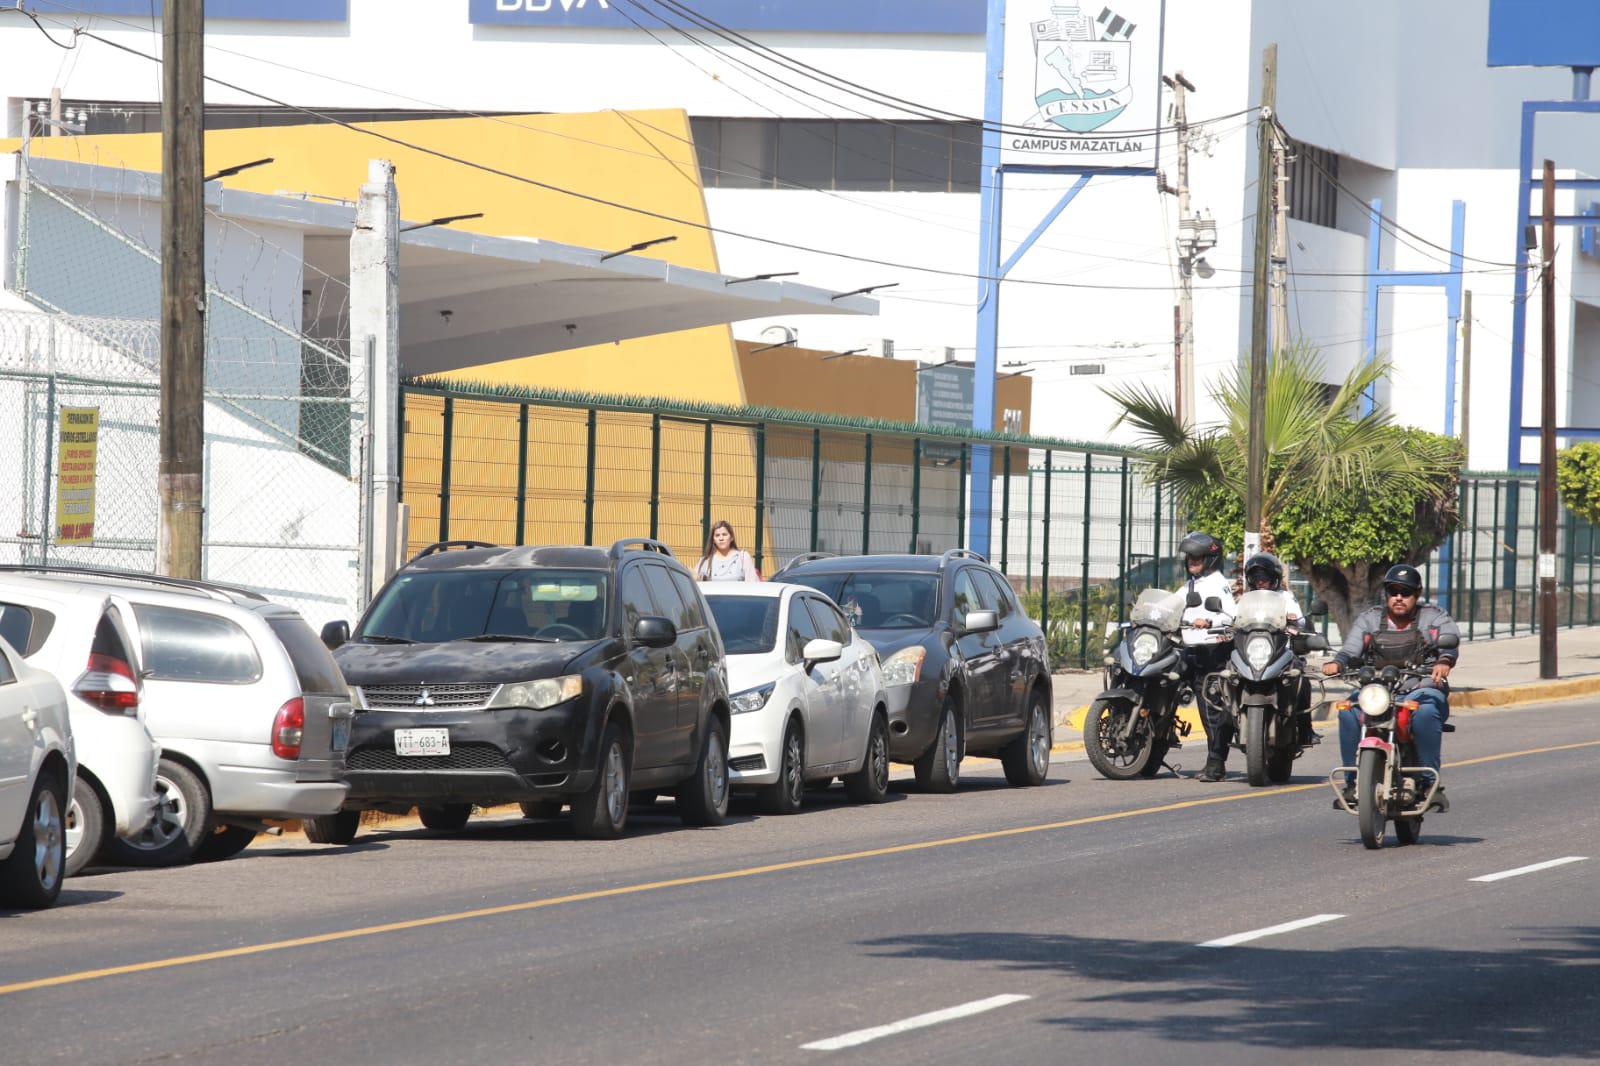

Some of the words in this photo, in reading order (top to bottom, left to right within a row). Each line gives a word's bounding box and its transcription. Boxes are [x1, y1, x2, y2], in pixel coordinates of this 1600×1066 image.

[1046, 96, 1121, 115] CESSSIN
[1012, 139, 1067, 150] CAMPUS
[1070, 138, 1142, 152] MAZATLÁN
